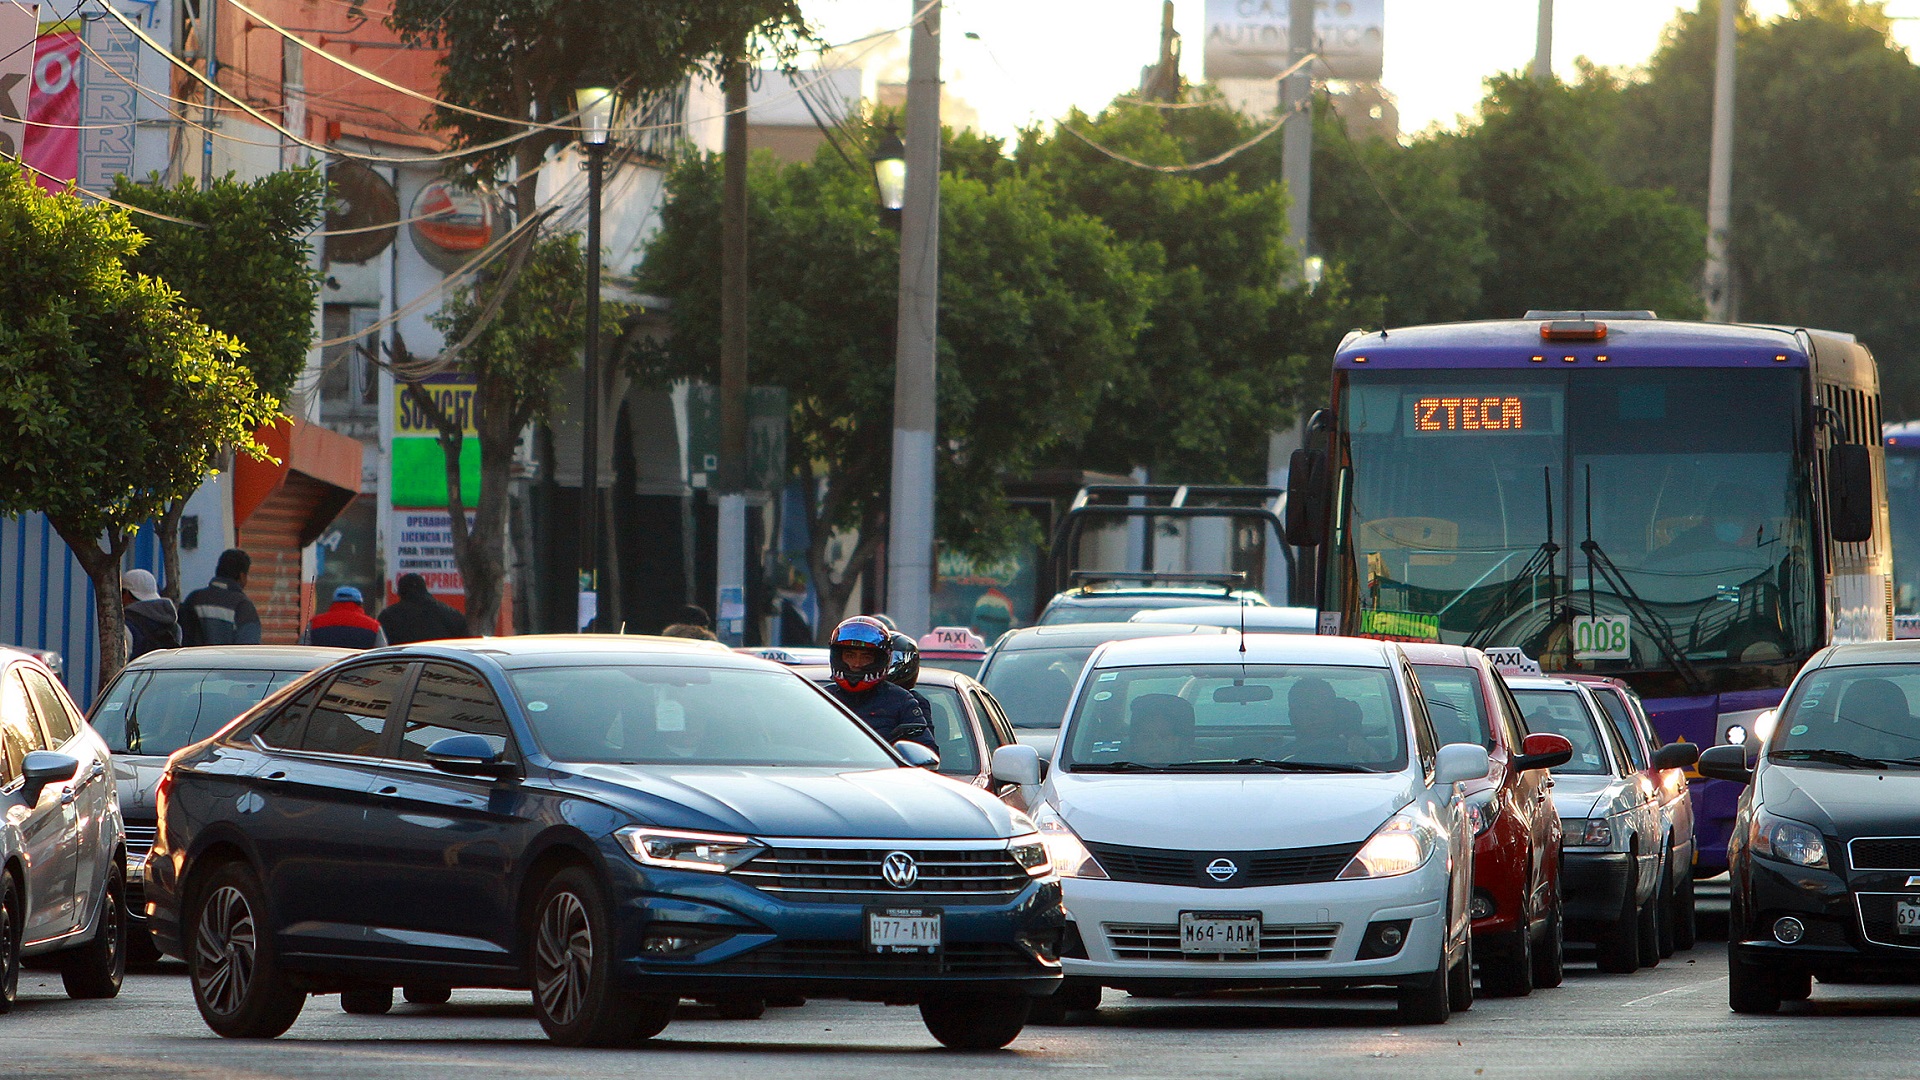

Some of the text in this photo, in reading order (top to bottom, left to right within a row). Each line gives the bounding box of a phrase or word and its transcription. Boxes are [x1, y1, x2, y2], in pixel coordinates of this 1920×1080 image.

[1207, 23, 1382, 46] AUTOTICO
[400, 389, 480, 430] SOCIT
[1414, 397, 1522, 430] ZTECA
[1360, 610, 1439, 639] XOCHIMILCO
[935, 631, 966, 644] TAXI
[1578, 621, 1626, 653] 008
[761, 652, 787, 661] TAXI
[1486, 652, 1520, 666] TAXI
[1898, 909, 1920, 924] 69
[873, 921, 938, 940] H77-AYN
[1186, 925, 1254, 941] M64-AAM
